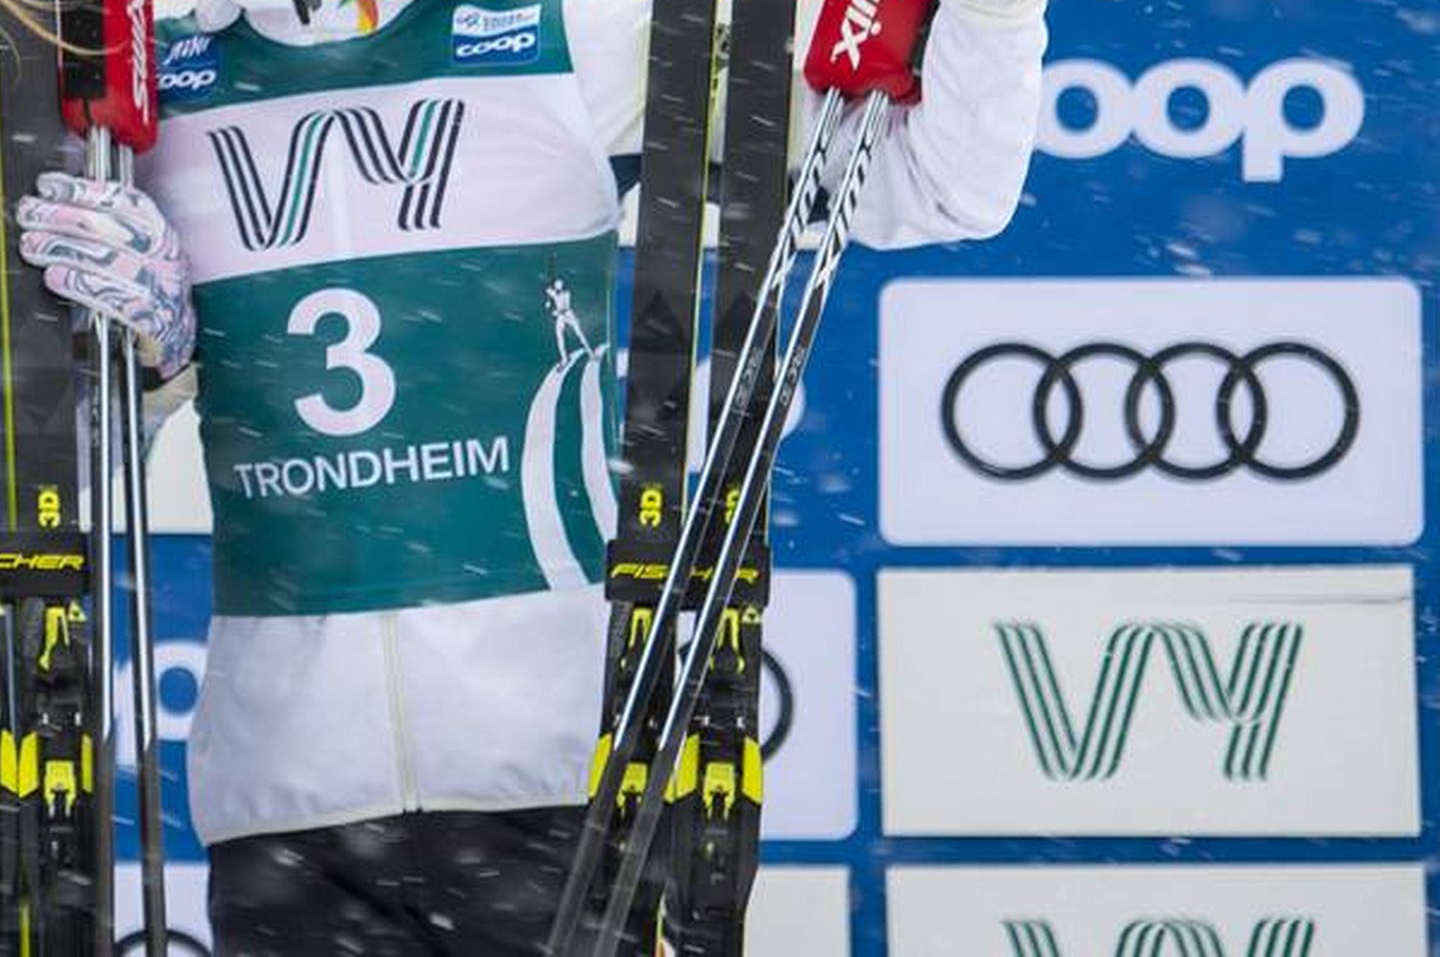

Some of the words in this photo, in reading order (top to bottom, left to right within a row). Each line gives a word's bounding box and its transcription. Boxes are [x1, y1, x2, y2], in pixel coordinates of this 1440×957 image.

[456, 32, 536, 58] coop
[158, 70, 216, 91] oop
[1036, 58, 1366, 183] oop
[286, 287, 397, 437] 3
[233, 436, 510, 499] TRONDHEIM
[38, 490, 61, 529] 3D
[638, 489, 663, 527] 3D
